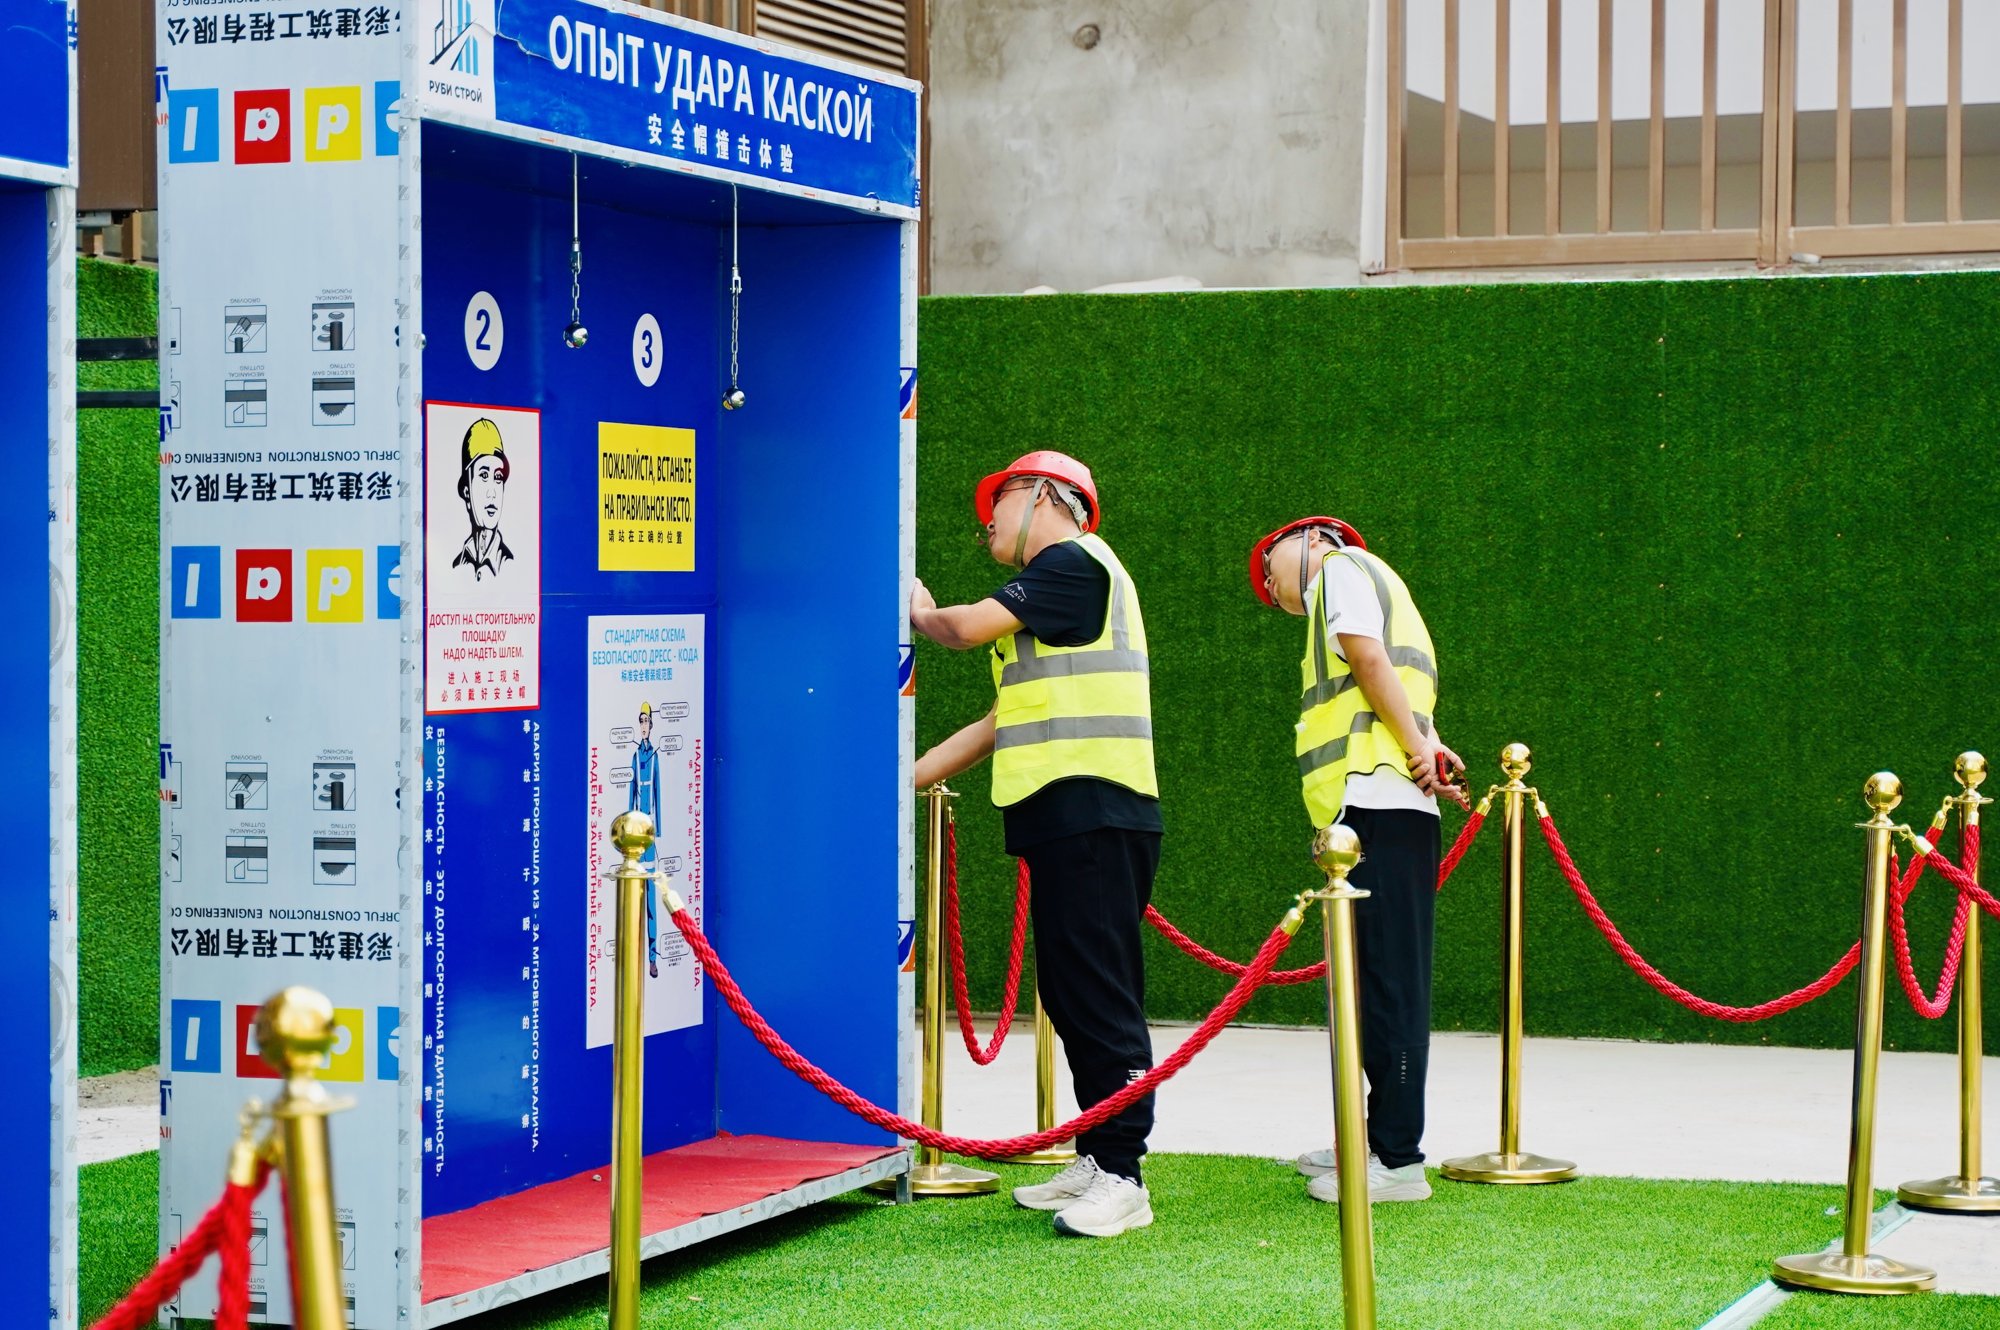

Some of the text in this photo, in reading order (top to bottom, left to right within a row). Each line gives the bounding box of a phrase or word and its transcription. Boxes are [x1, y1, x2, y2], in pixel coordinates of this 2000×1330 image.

[168, 6, 400, 46] 彩建筑工程有限公
[429, 80, 483, 103] РУБИ СТРОЙ
[549, 14, 873, 144] ОПЫТ УДАРА КАСКОЙ
[648, 112, 794, 174] 安全帽撞击体验
[475, 309, 491, 352] 2
[641, 330, 654, 367] 3
[184, 452, 262, 464] ENGINEERING
[268, 450, 360, 462] CONSTRUCTION
[603, 448, 692, 485] ПОЖАЛУЙСТА, ВСТАНЬТЕ
[171, 470, 400, 503] 彩建筑工程有限公
[604, 493, 692, 523] НА ПРАВИЛЬНОЕ МЕСТО.
[608, 529, 682, 544] 请站在正确的位置
[429, 613, 536, 628] ДОСТУП НА СТРОИТЕЛЬНУЮ
[462, 630, 507, 644] ПЛОЩАДКУ
[604, 627, 686, 646] СТАНДАРТНАЯ СХЕМА
[443, 646, 524, 662] НАДО НАДЕТЬ ШЛЕМ.
[592, 650, 648, 666] БЕЗОПАСНОГО
[649, 648, 672, 665] ДРЕСС
[678, 648, 699, 664] КОДА
[448, 669, 520, 685] 进入施工现场
[441, 686, 526, 702] 必须戴好安全帽
[436, 728, 445, 855] БЕЗОПАСНОСТЬ
[589, 747, 599, 1012] НАДЕНЬ ЗАЩИТНЫЕ СРЕДСТВА.
[693, 739, 702, 992] НАДЕНЬ ЗАЩИТНЫЕ СРТВА.
[436, 870, 445, 902] ЭТО
[533, 889, 540, 909] ИЗ
[185, 907, 263, 919] ENGINEERING
[269, 909, 361, 922] CONSTRUCTION
[171, 927, 400, 962] 彩建筑工程有限公
[533, 923, 540, 942] ЗА
[435, 905, 445, 1040] ДОЛГОСРОЧНАЯ
[532, 946, 540, 1060] МГНОВЕННОГО
[435, 1044, 445, 1178] БДИТЕЛЬНОСТЬ.
[532, 1064, 540, 1153] ПАРАЛИЧА.
